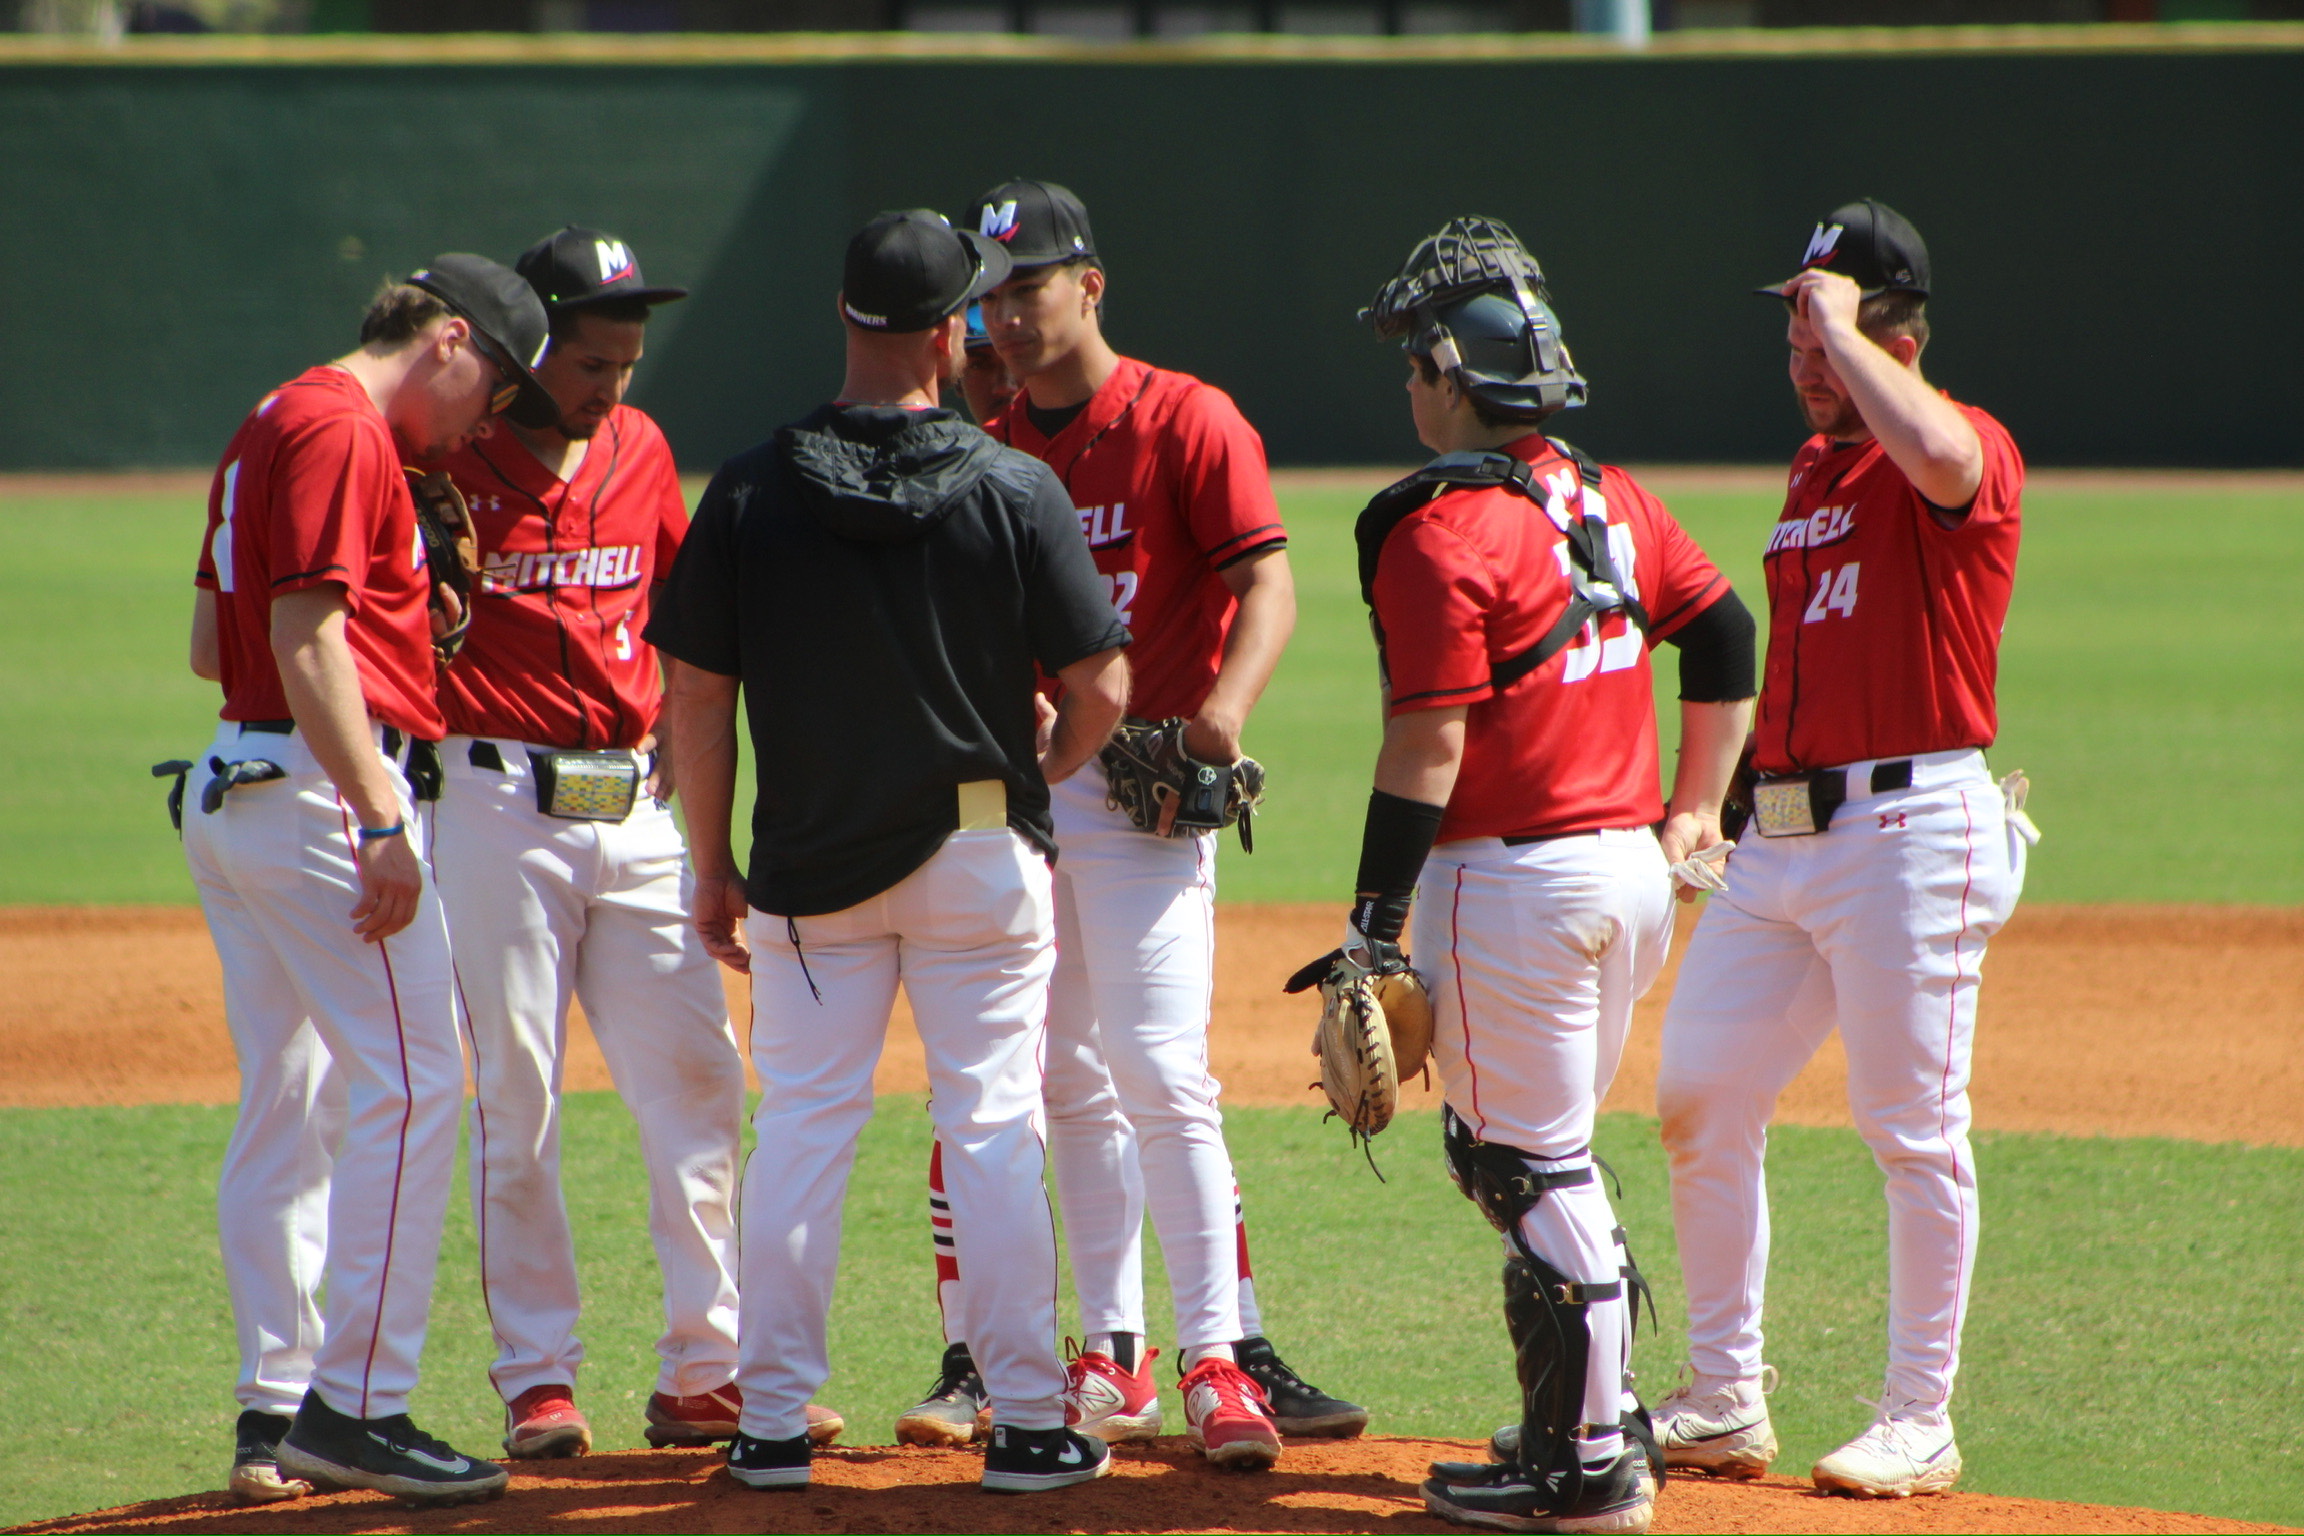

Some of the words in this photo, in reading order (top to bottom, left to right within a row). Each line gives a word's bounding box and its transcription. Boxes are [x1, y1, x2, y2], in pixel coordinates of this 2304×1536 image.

[980, 200, 1018, 237] M
[594, 238, 629, 281] M
[1801, 221, 1844, 265] M
[481, 545, 641, 593] MITCHELL
[1804, 562, 1860, 624] 24
